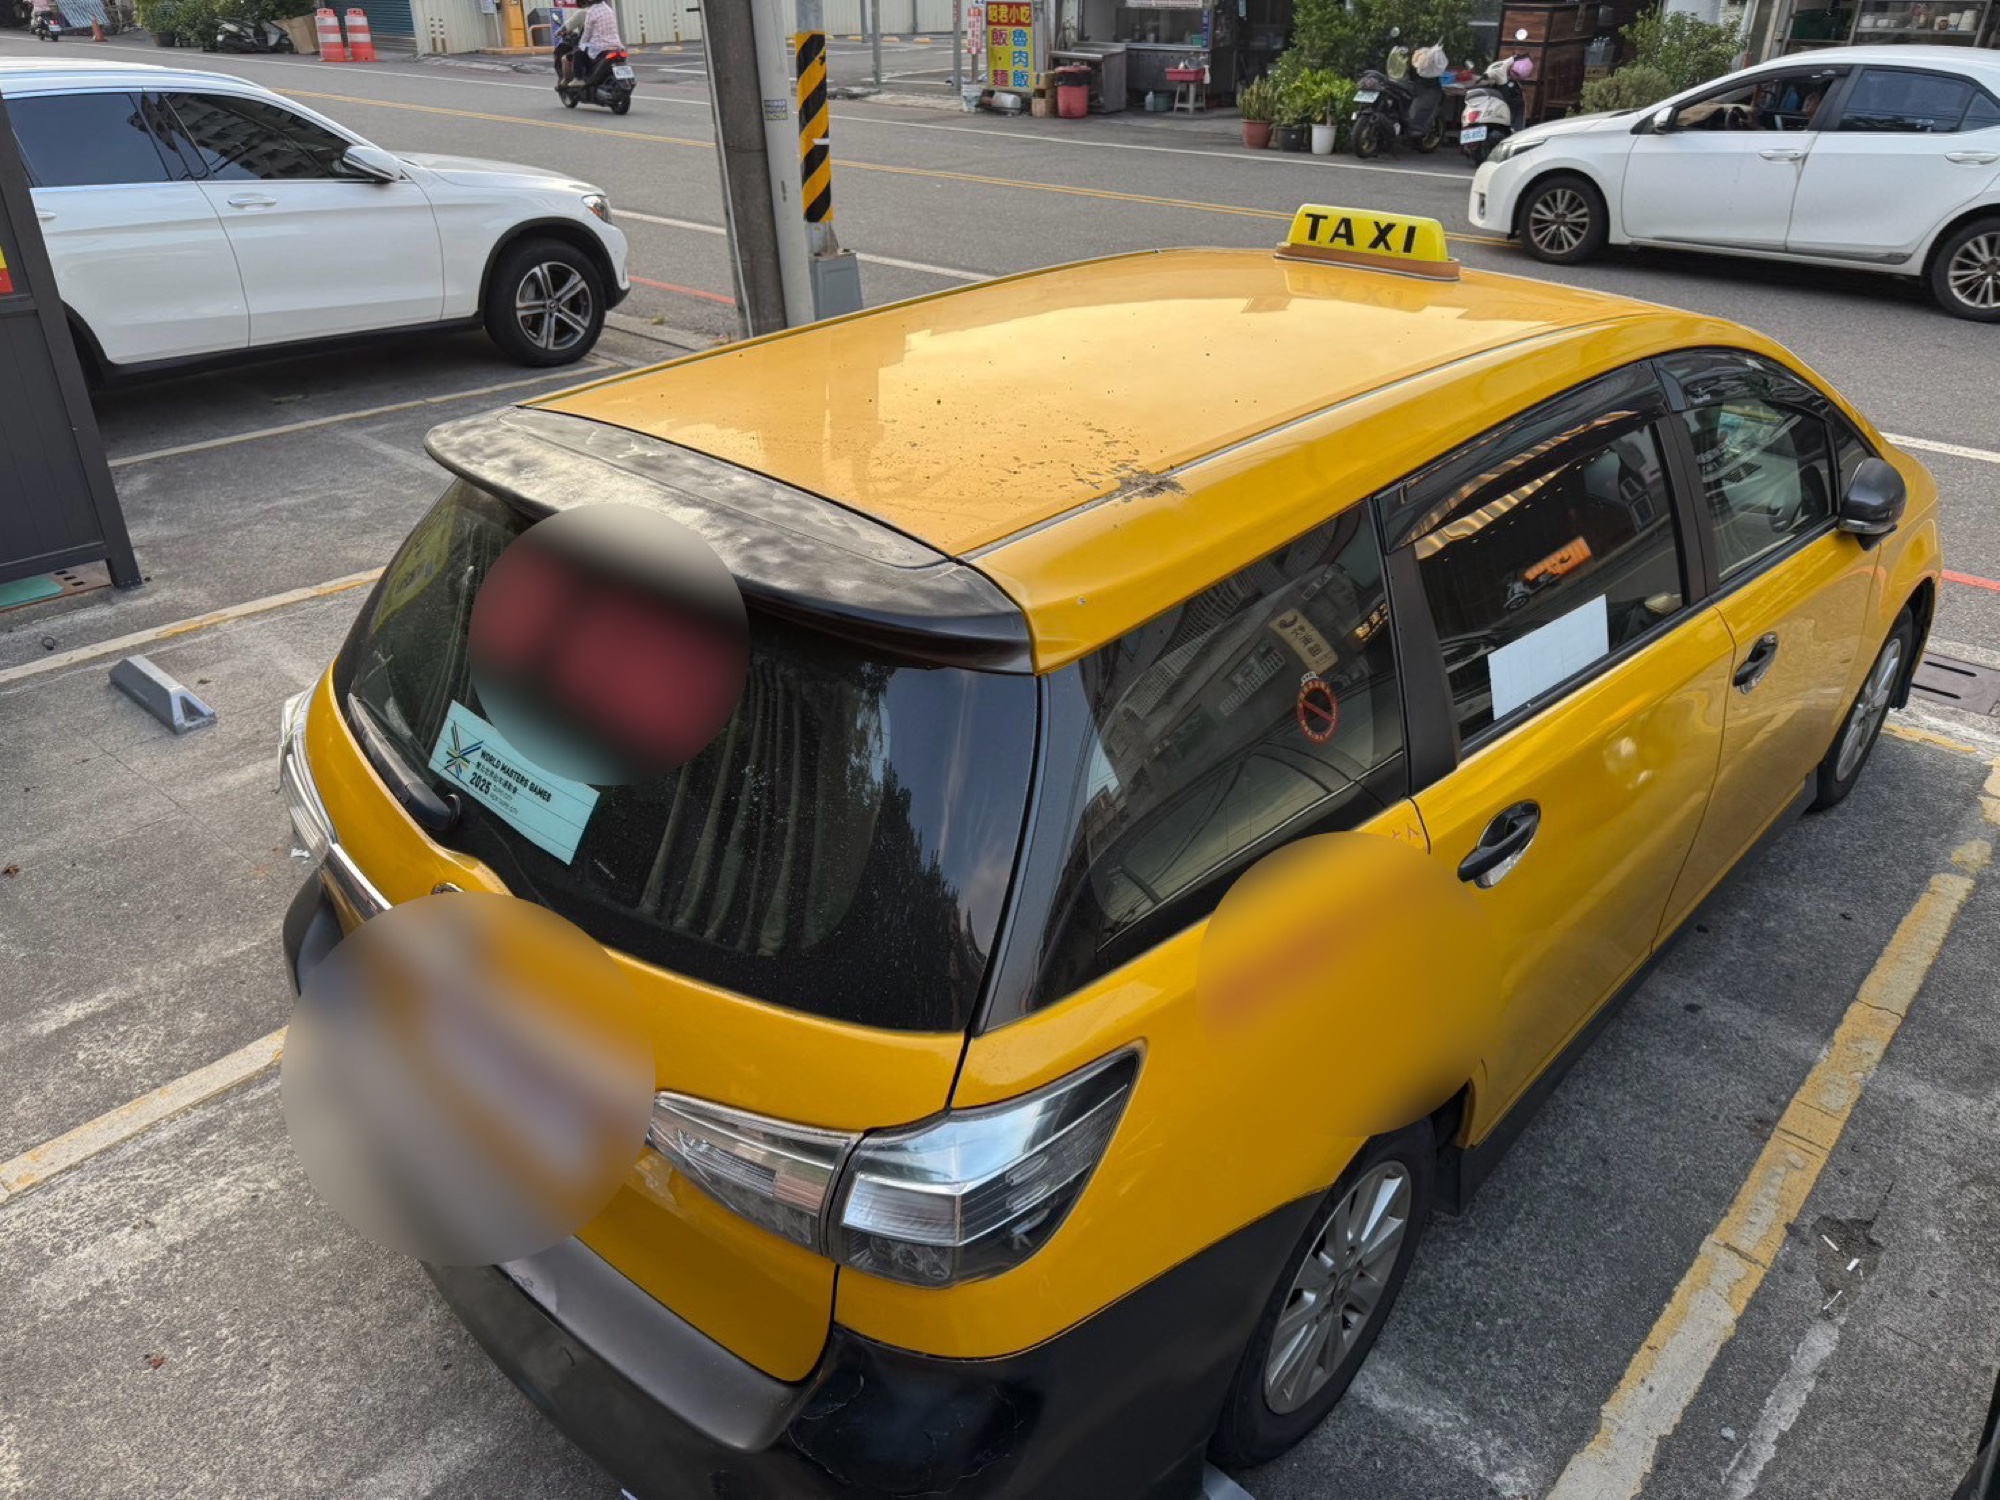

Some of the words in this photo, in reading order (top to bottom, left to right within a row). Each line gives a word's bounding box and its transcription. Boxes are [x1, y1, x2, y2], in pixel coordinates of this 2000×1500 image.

[1012, 29, 1030, 88] 魯肉飯
[1305, 213, 1417, 254] TAXI
[469, 771, 492, 795] 2025
[480, 749, 501, 769] WORLD
[501, 762, 530, 789] MASTERS
[528, 782, 552, 803] GAMES
